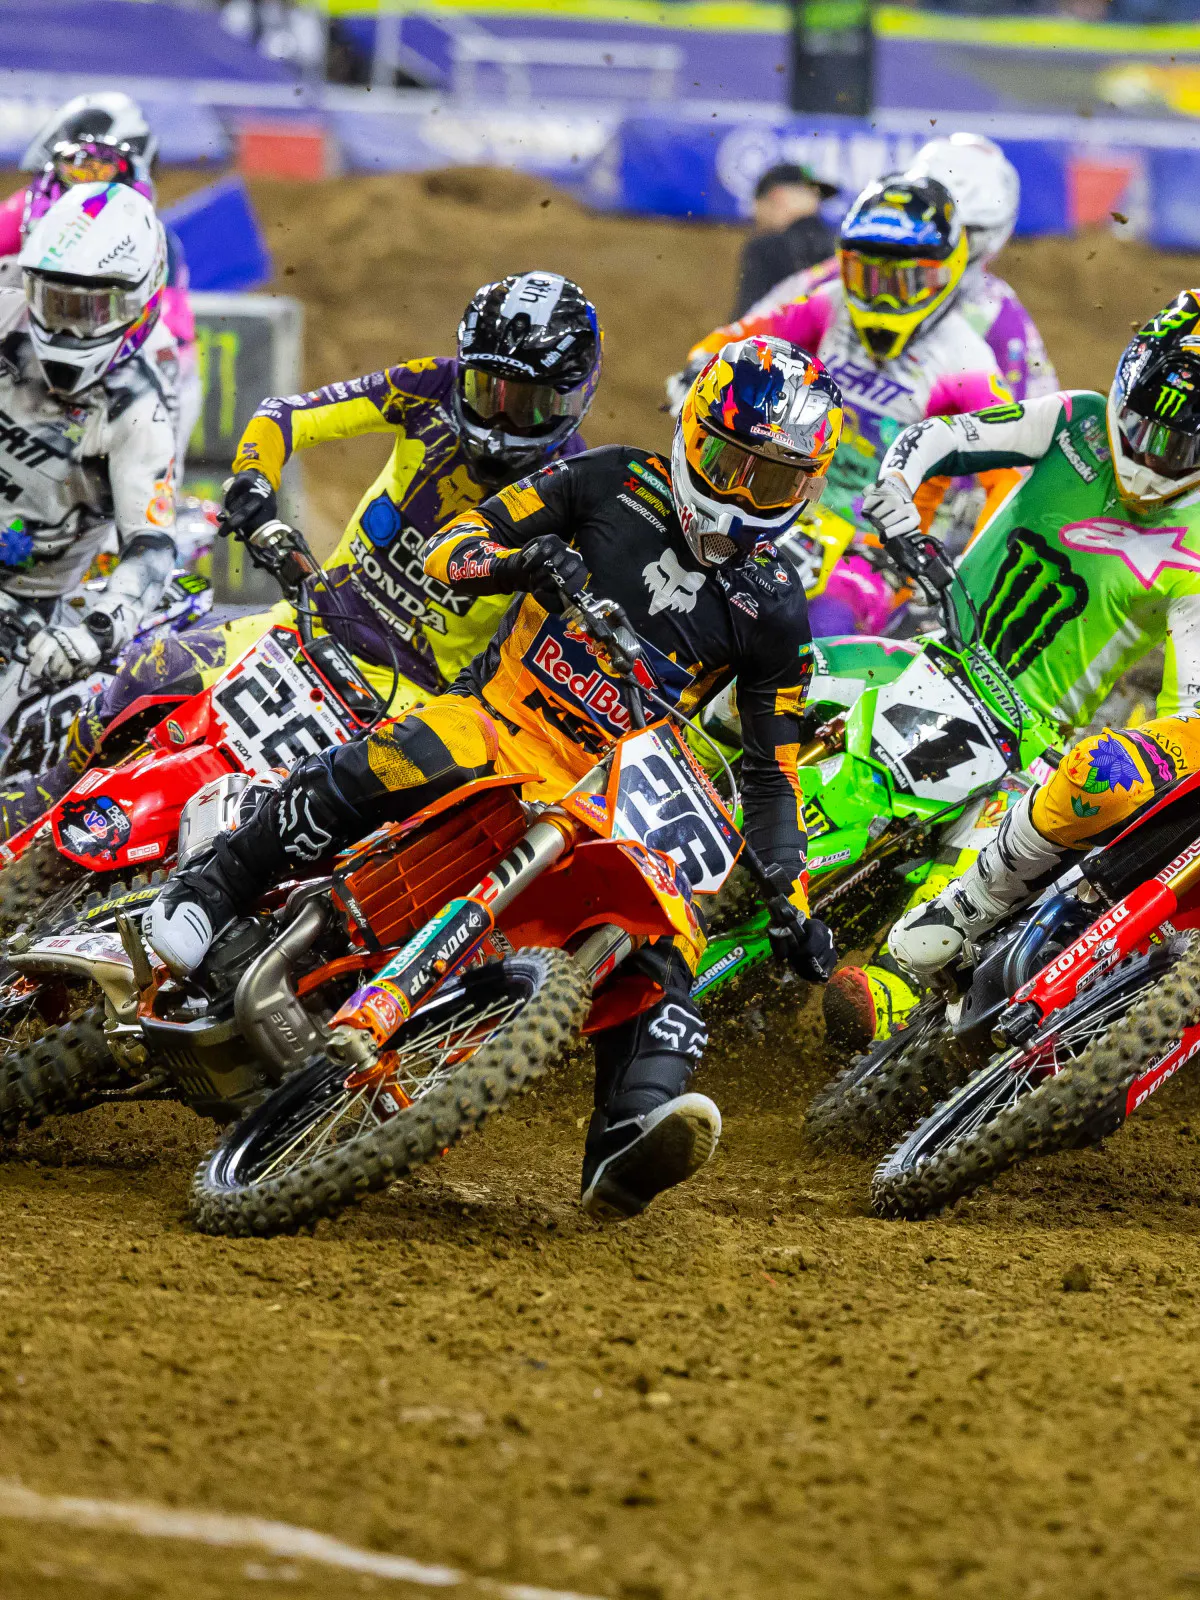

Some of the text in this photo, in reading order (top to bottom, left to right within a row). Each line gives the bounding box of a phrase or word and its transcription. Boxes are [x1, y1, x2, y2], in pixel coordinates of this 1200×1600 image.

[462, 352, 538, 378] HONDA
[0, 408, 69, 469] EATT
[1056, 428, 1098, 484] Kawasaki
[617, 493, 667, 533] PROGRESSIVE
[350, 533, 448, 635] HONDA
[388, 541, 470, 614] LOCK
[450, 558, 492, 580] Red Bull
[730, 597, 758, 619] RENTHAL
[533, 634, 656, 733] Red Bu
[232, 739, 252, 761] SKDA
[575, 795, 608, 821] LOVE MOTO
[679, 759, 719, 819] SUPERCROSS
[86, 810, 107, 829] VP
[615, 754, 726, 886] 26
[86, 888, 161, 919] DUNLOP
[347, 898, 362, 918] Twin
[409, 924, 471, 997] DUNOP
[1044, 903, 1130, 985] DUNLOP
[691, 946, 744, 991] CARRILLO
